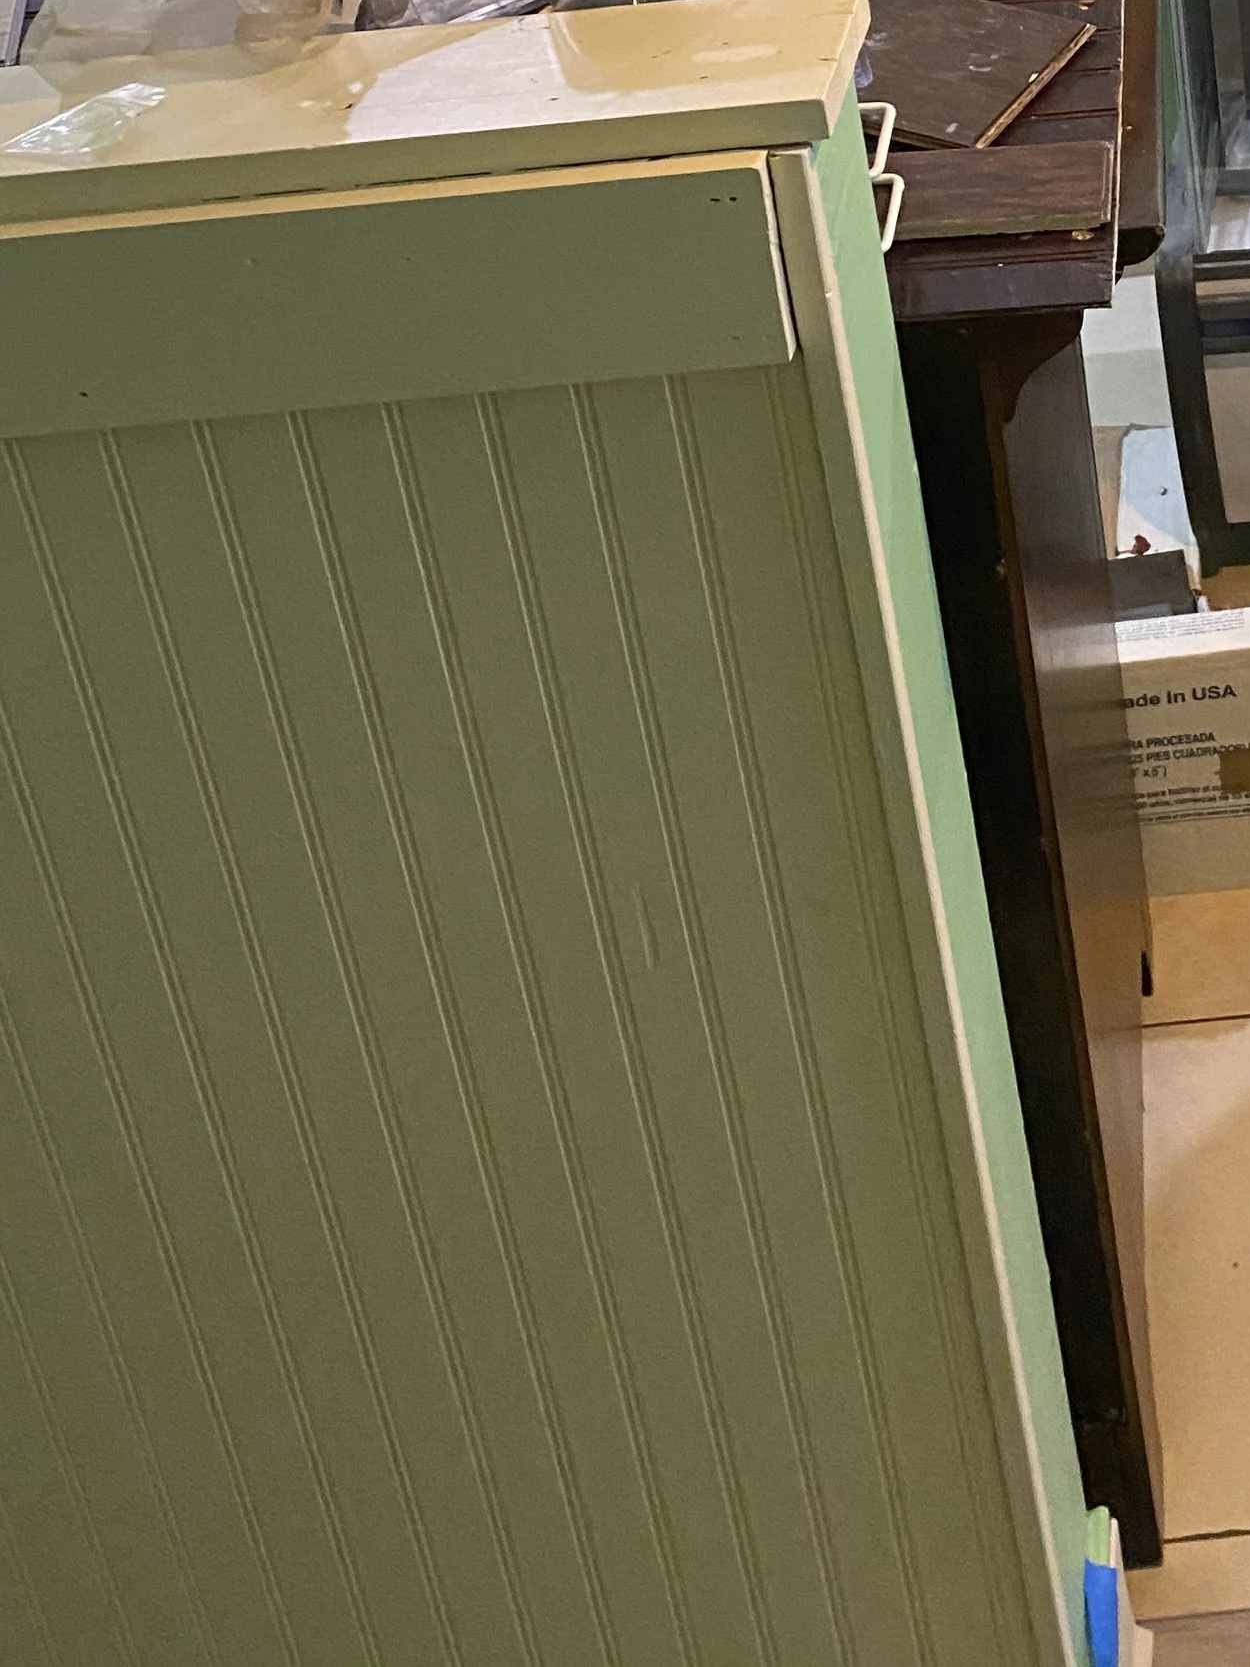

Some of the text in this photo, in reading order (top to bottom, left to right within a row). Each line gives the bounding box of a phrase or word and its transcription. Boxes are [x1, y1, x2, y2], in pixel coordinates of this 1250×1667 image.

[1121, 684, 1237, 709] ade In USA
[1145, 731, 1217, 748] PROCESADA
